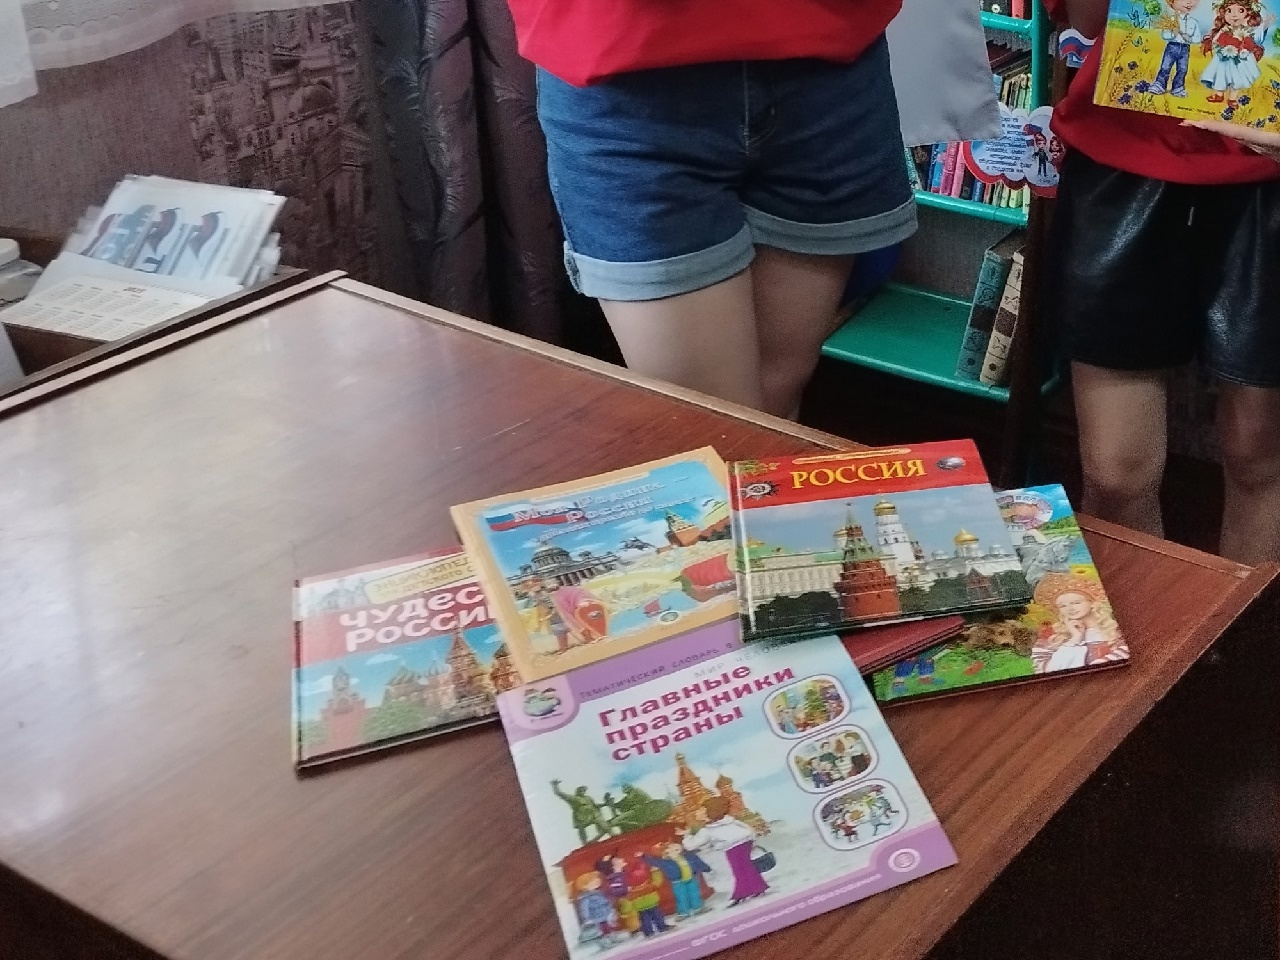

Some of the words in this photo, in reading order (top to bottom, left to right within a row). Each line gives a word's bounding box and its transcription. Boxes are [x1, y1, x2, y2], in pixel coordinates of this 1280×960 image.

[790, 459, 926, 489] РОССИЯ
[598, 665, 752, 727] Главные
[605, 667, 795, 745] праздники
[611, 706, 744, 761] страны
